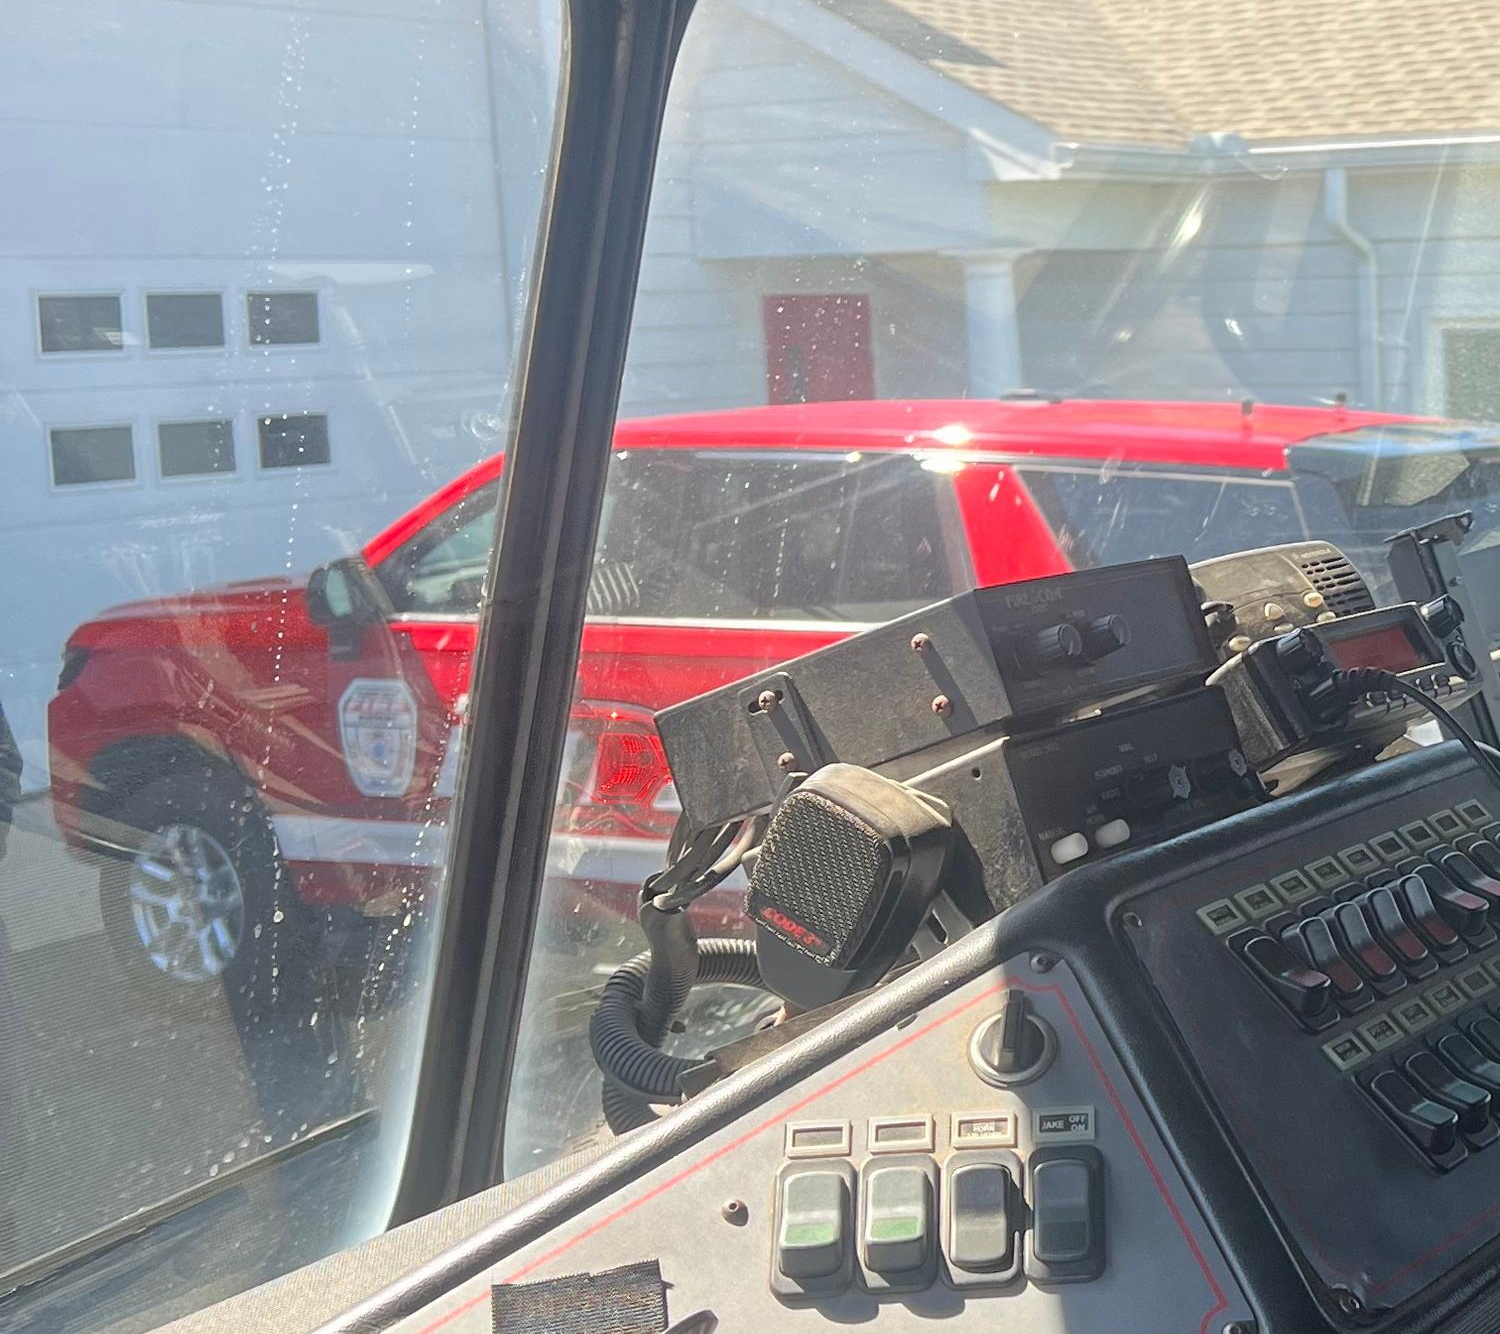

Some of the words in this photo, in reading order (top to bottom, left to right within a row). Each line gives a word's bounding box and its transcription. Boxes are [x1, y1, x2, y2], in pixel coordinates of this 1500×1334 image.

[763, 907, 807, 940] CODE
[1069, 1115, 1087, 1123] OFF
[1041, 1120, 1065, 1130] JAKE
[1071, 1123, 1085, 1132] ON
